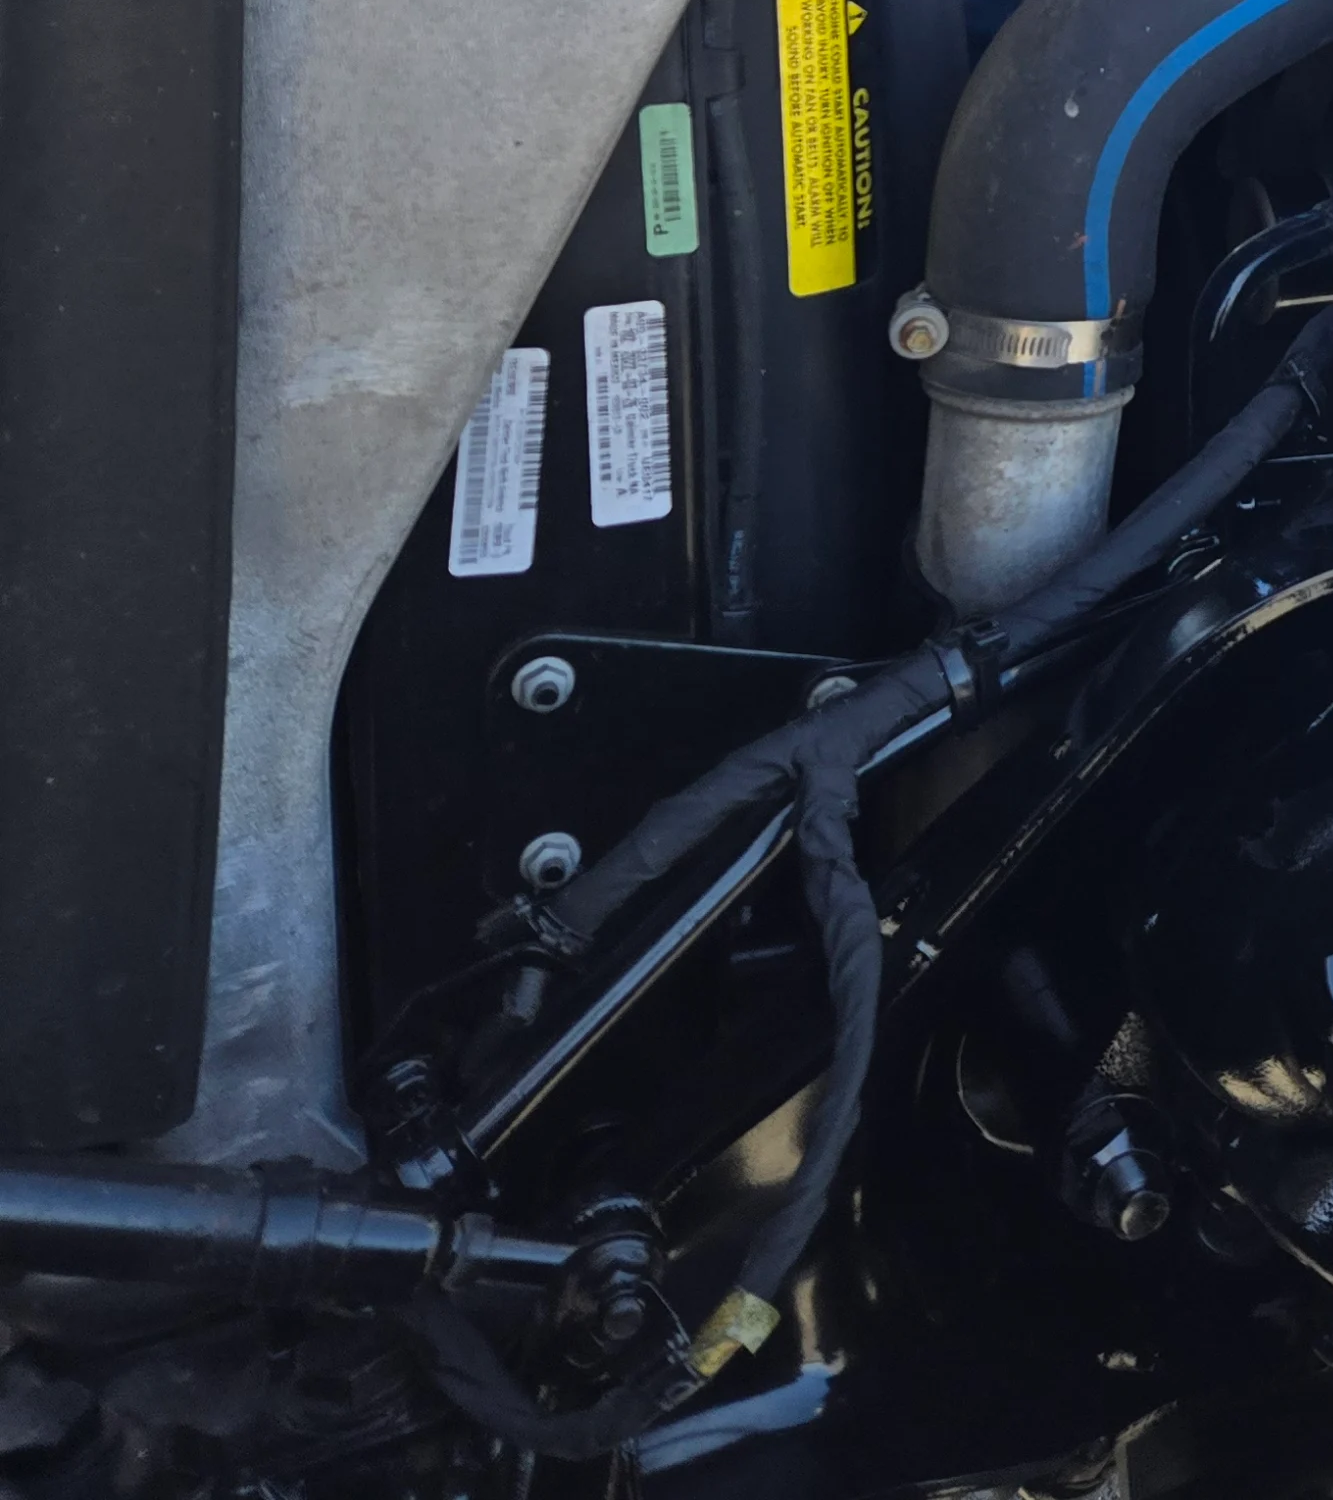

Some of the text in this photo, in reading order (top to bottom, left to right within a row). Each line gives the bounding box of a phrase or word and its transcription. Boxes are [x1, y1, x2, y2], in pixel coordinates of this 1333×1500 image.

[801, 0, 813, 60] WORKING
[815, 0, 827, 36] AVOID
[787, 26, 801, 69] SOUND
[830, 44, 842, 84] COULD
[803, 65, 815, 84] ON
[790, 73, 801, 116] BEFORE
[805, 88, 816, 113] FAN
[821, 88, 831, 119] TURN
[833, 88, 844, 121] START
[805, 116, 818, 134] OR
[791, 121, 804, 190] AUTOMATIC
[821, 122, 834, 178] IGNITION
[808, 178, 821, 218] ALARM
[823, 181, 834, 203] OFF
[810, 221, 823, 248] WILL
[824, 207, 836, 245] WHEN
